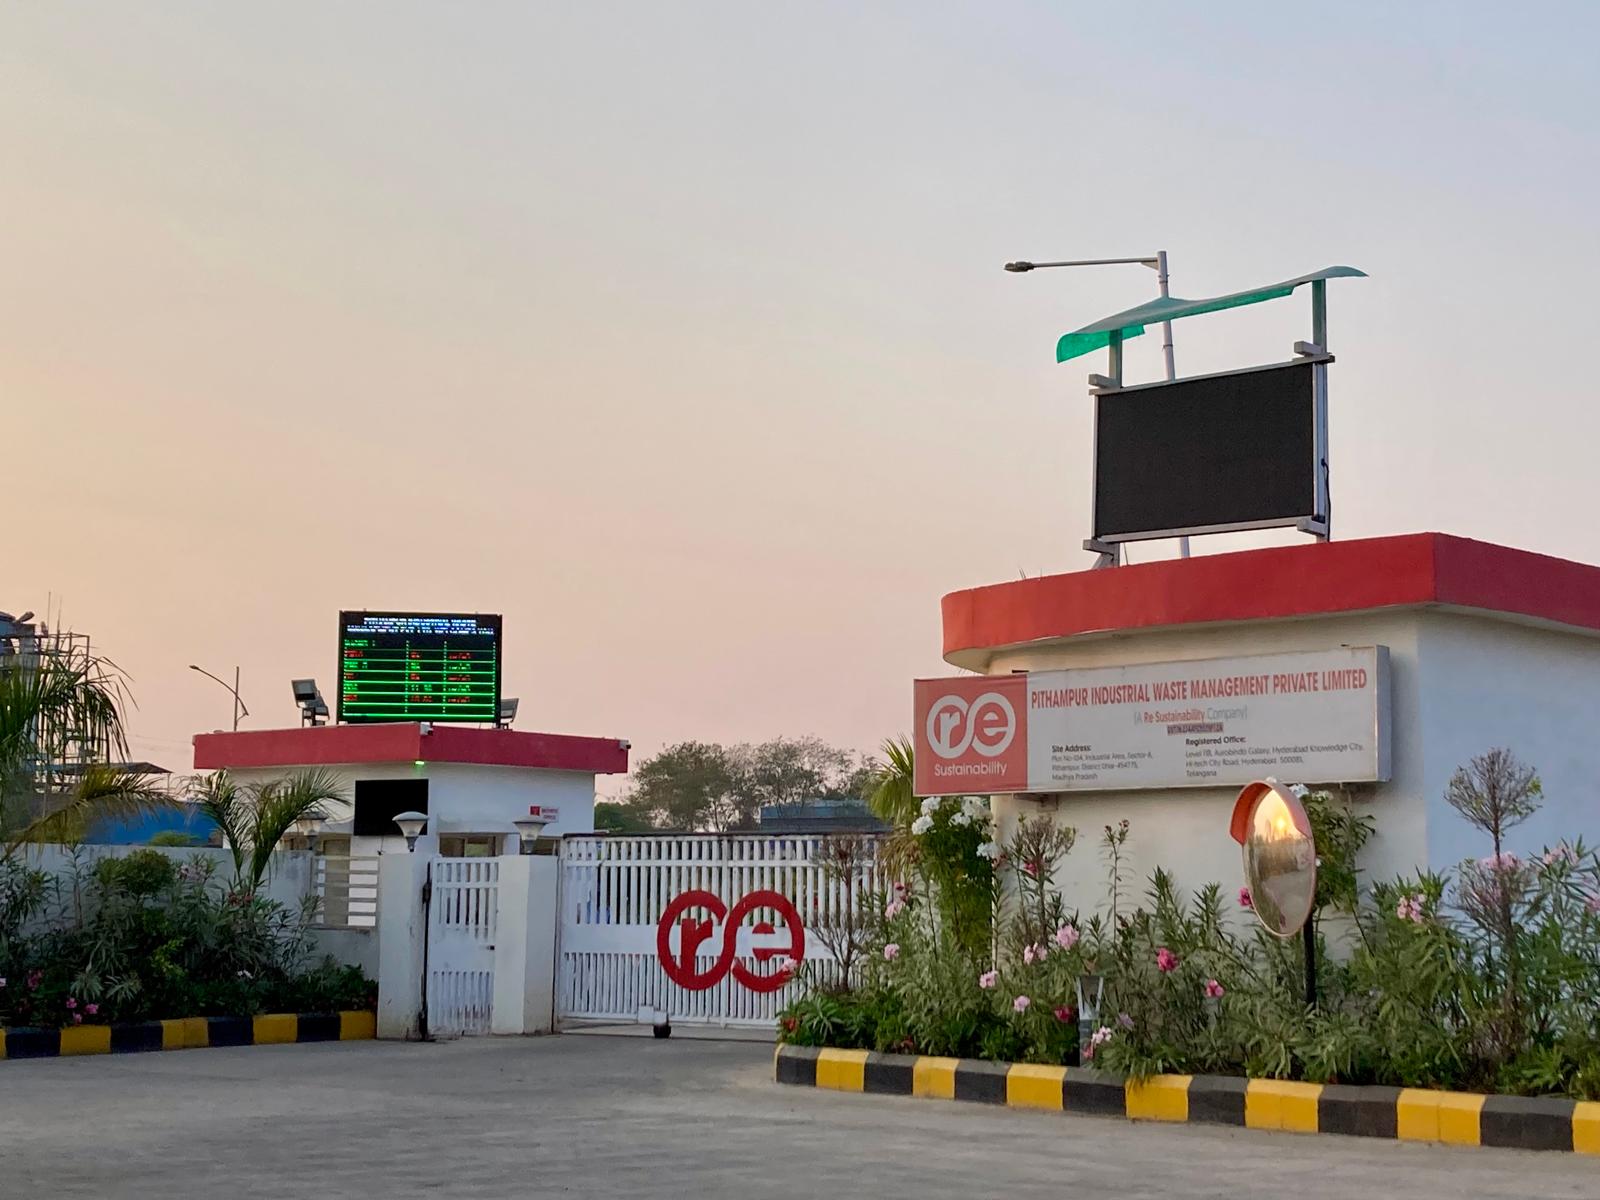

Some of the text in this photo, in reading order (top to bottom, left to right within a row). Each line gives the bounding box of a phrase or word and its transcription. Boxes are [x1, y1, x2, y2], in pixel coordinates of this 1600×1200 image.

[1031, 668, 1368, 709] PITHAMPUR INDUSTRIAL WASTE MANAGEMENT PRIVATE LIMITED
[1143, 711, 1153, 723] Re
[1155, 707, 1206, 722] Sustainability
[1186, 735, 1247, 747] Registered Office:
[1052, 745, 1064, 753] Site
[1271, 744, 1309, 754] Hyderabad
[1310, 743, 1348, 753] Knowledge
[934, 761, 1008, 778] Sustainability
[1186, 770, 1217, 779] Telangana
